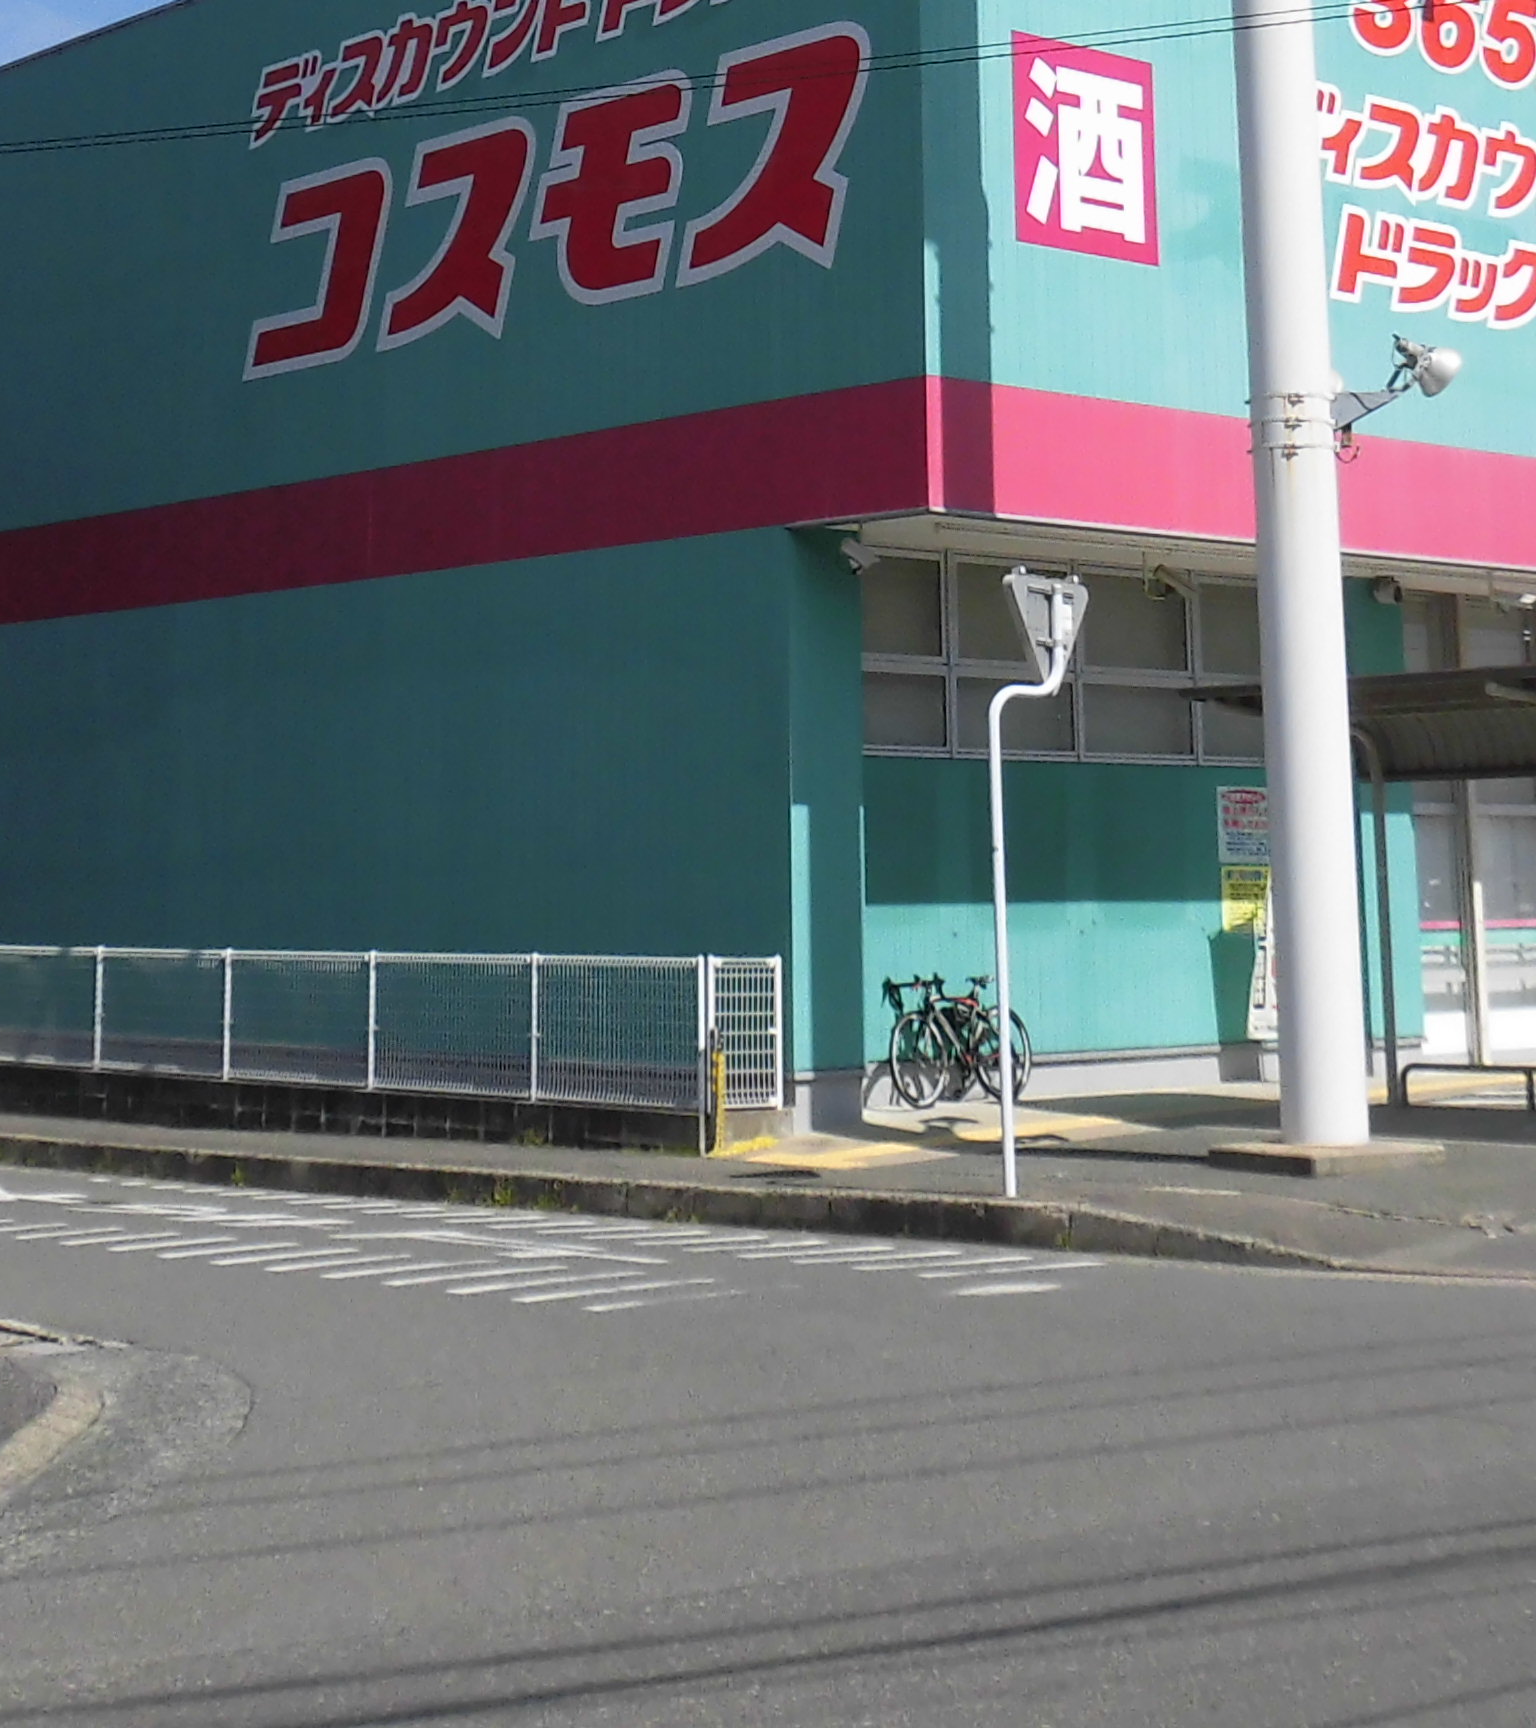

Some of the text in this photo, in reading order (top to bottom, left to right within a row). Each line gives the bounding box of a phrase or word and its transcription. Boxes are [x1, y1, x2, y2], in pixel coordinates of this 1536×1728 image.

[242, 20, 871, 382] コスモス
[1024, 57, 1146, 244] 酒
